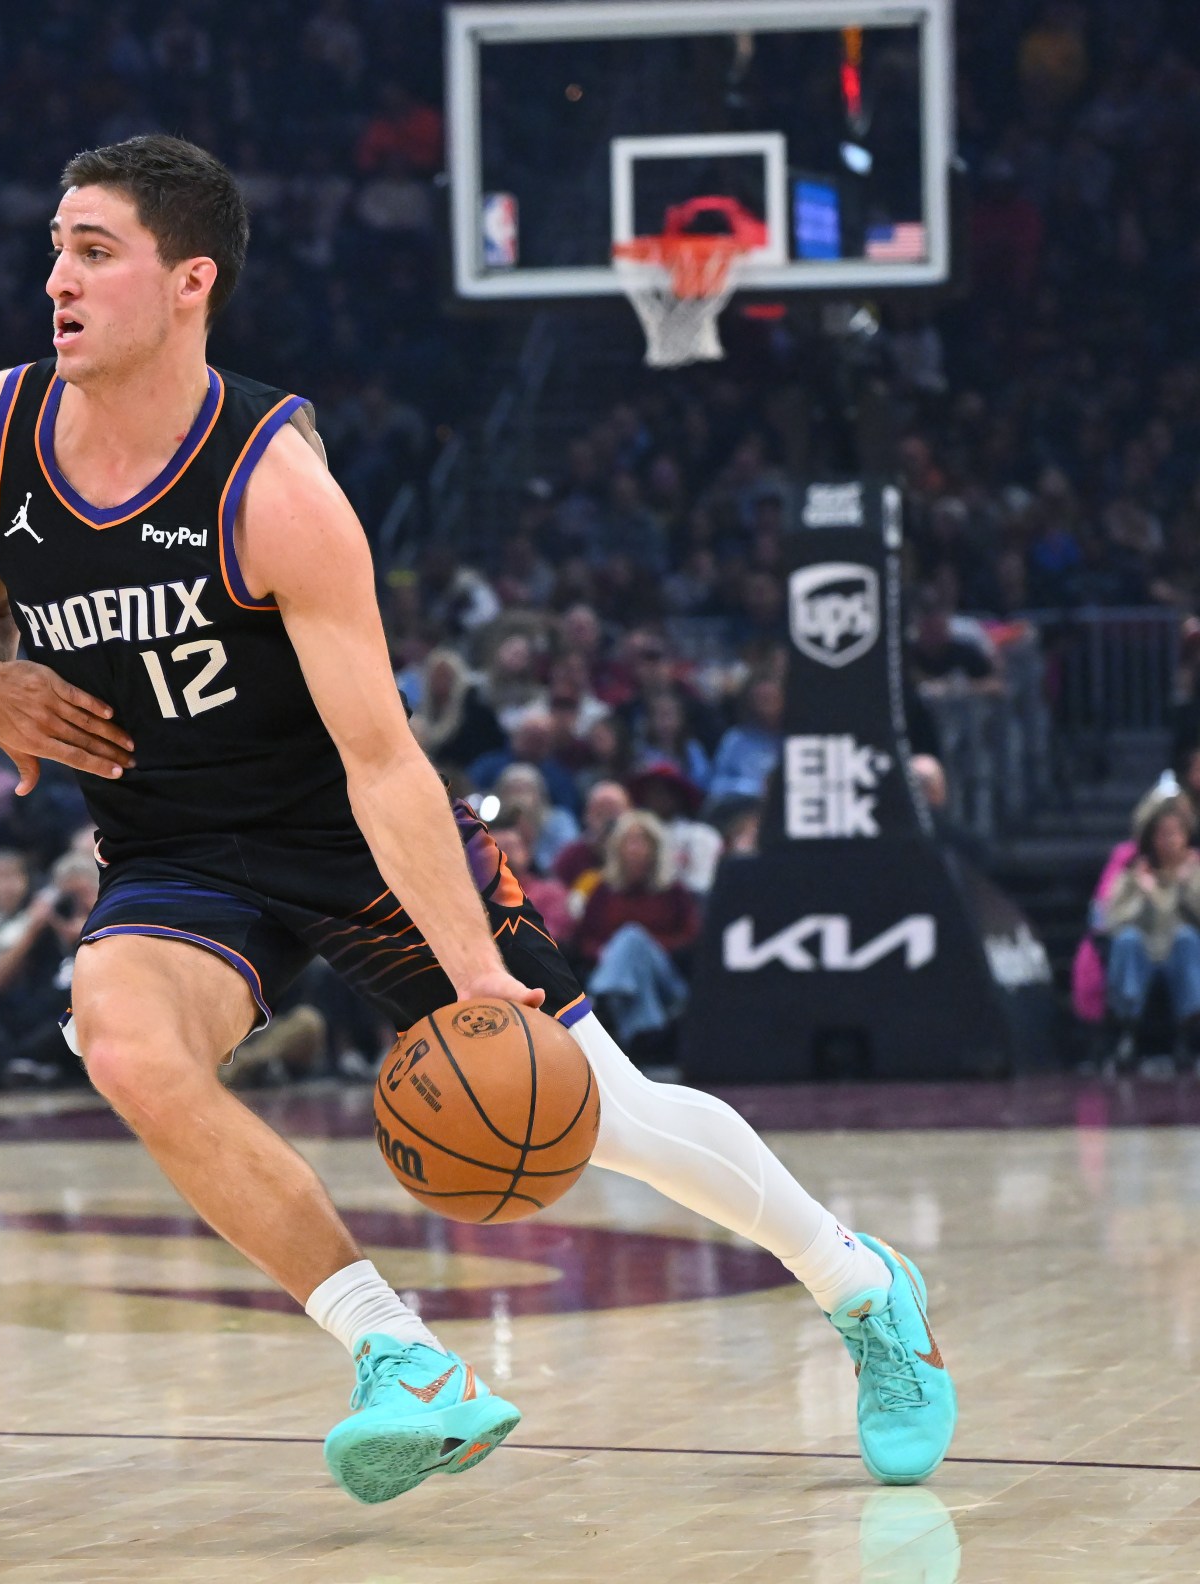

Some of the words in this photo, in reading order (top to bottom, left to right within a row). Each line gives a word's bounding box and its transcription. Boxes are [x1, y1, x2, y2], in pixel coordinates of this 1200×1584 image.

[141, 523, 208, 549] PayPal
[15, 577, 214, 651] PHOENIX
[139, 639, 238, 719] 12
[785, 793, 880, 839] Elk
[722, 913, 938, 971] KIA
